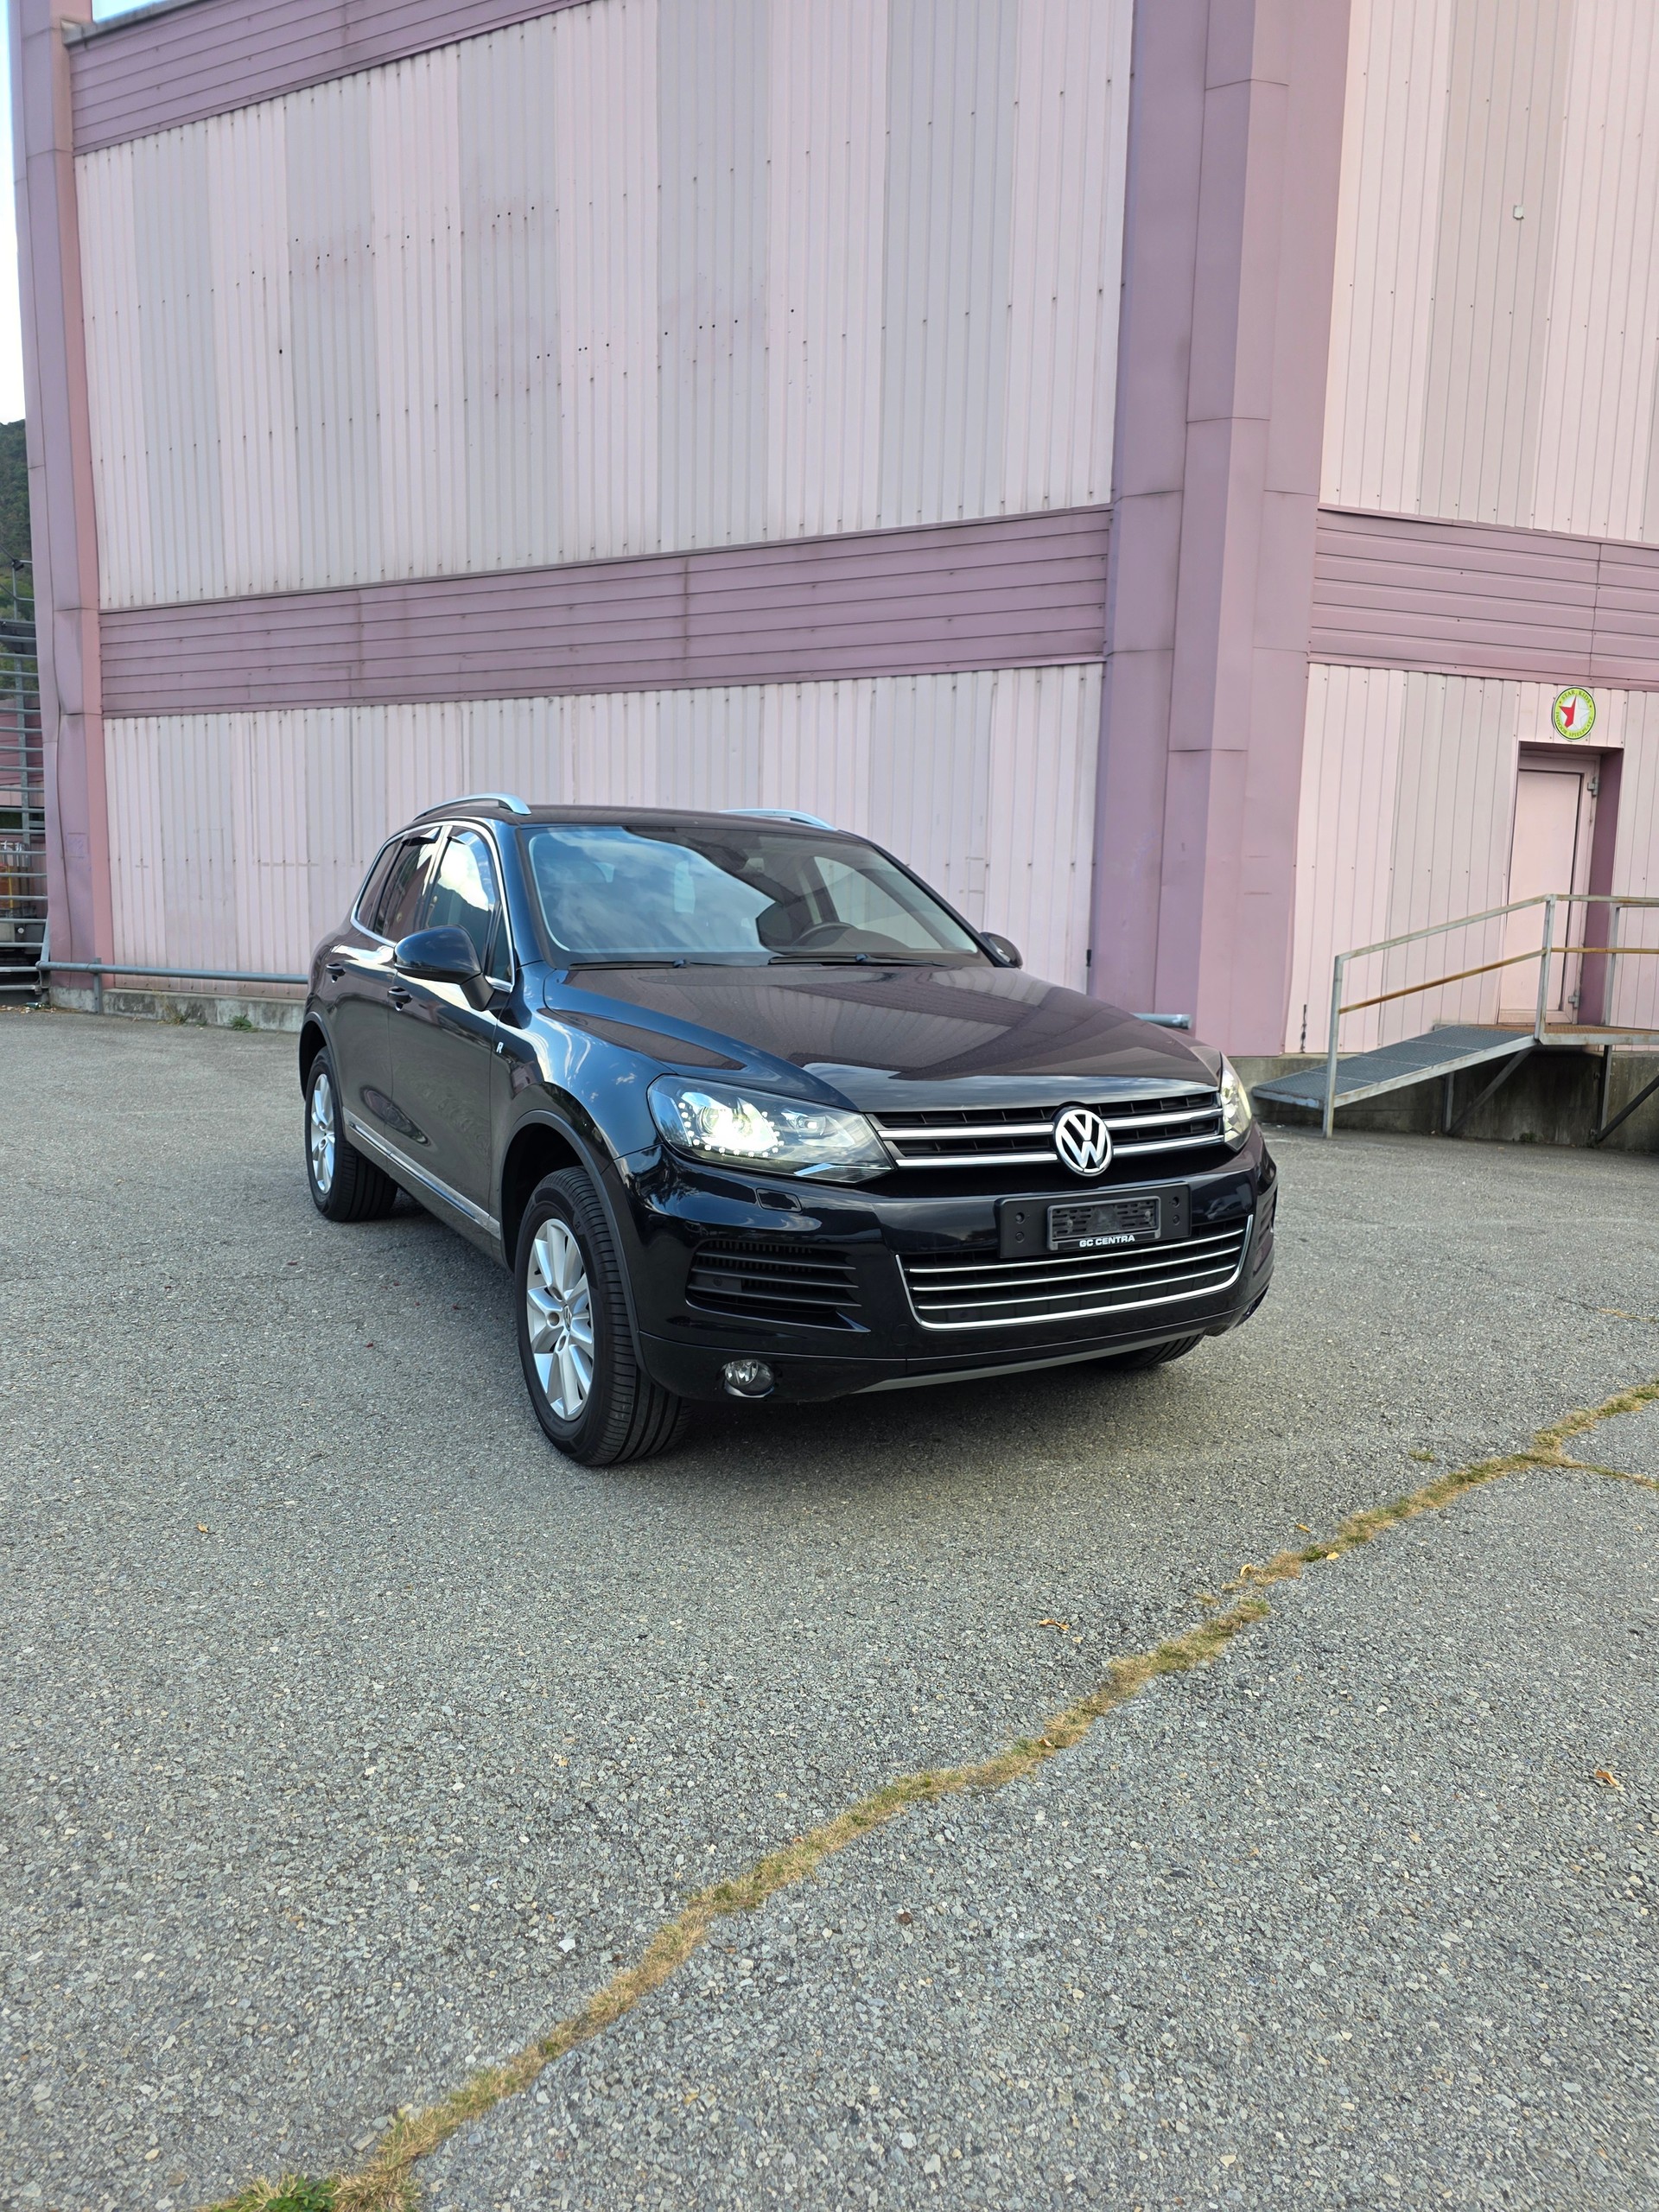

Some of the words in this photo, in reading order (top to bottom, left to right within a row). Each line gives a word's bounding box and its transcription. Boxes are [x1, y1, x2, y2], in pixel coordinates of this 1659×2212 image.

[1561, 690, 1575, 700] STAR
[1578, 690, 1591, 703] KIDS
[1555, 711, 1567, 734] INDOOR
[1056, 1109, 1112, 1175] VW
[1079, 1239, 1094, 1248] GC
[1095, 1234, 1135, 1246] CENTRA
